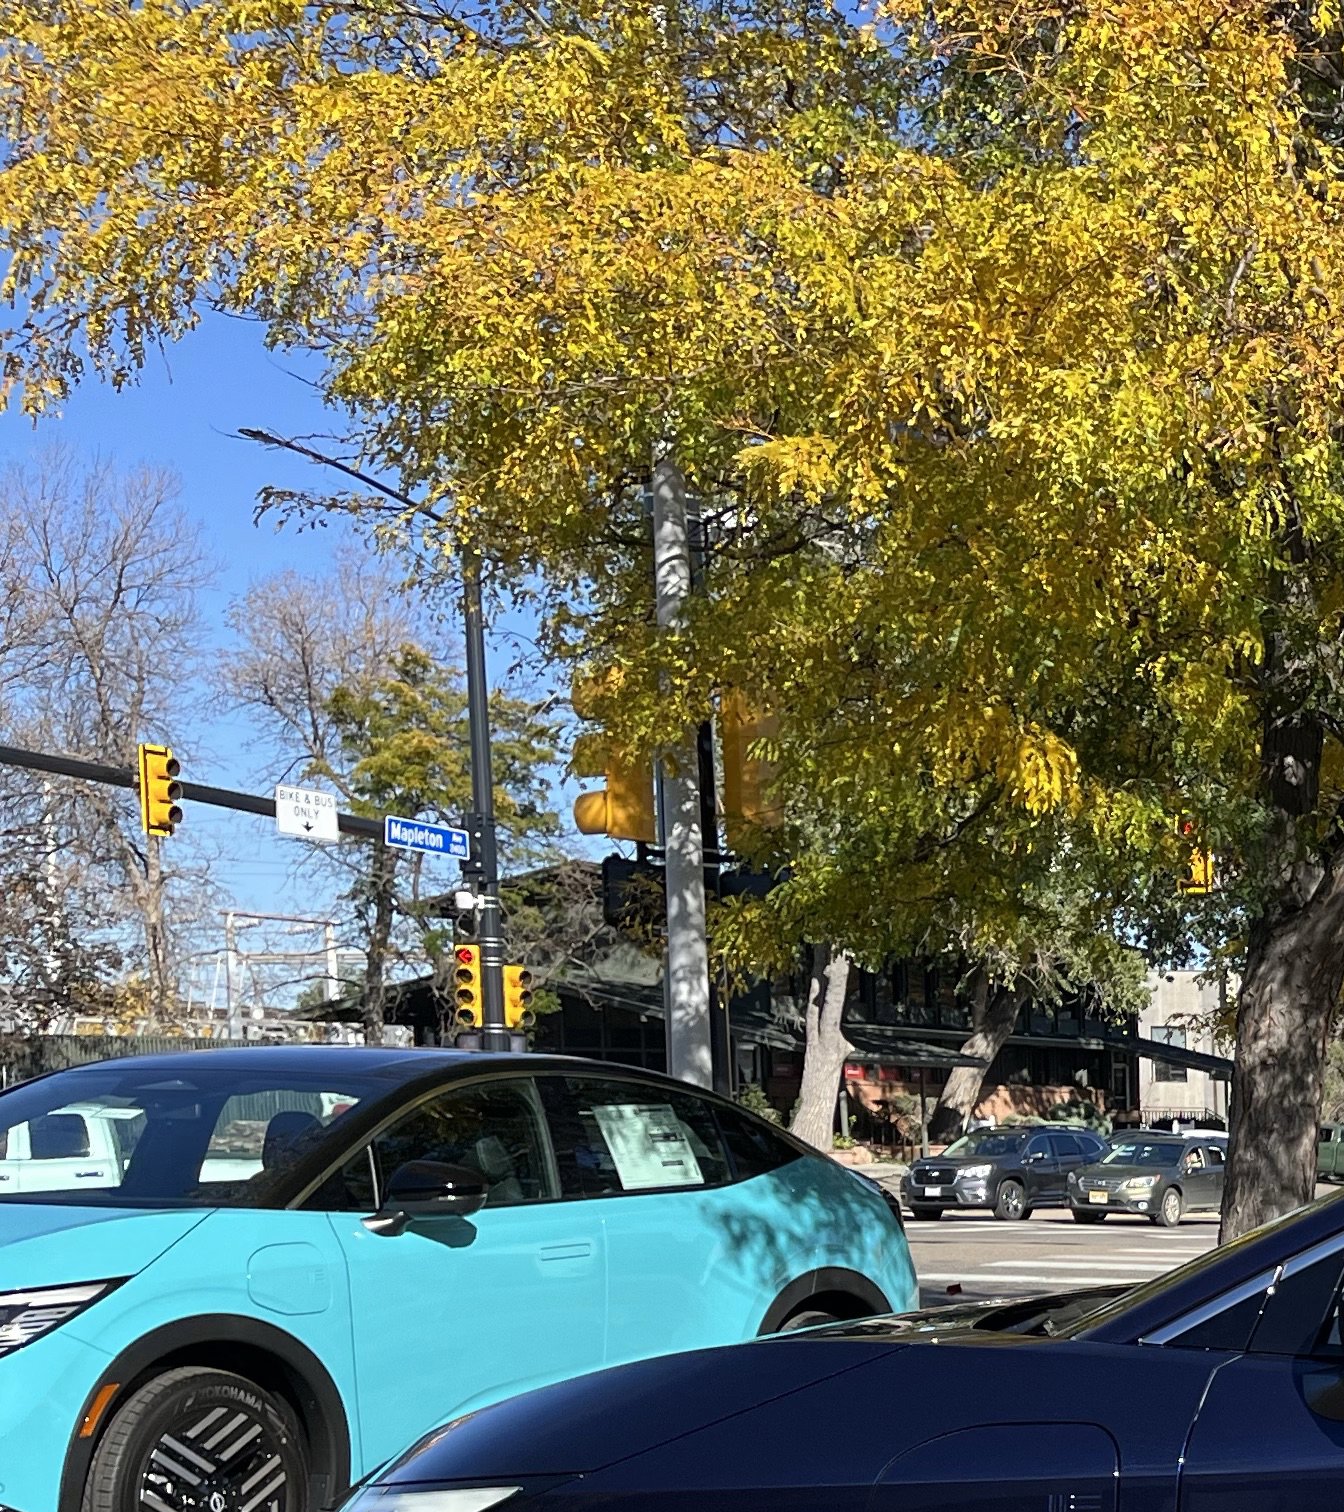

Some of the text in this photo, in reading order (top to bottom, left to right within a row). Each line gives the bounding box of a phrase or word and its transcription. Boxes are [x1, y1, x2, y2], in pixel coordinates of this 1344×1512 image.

[279, 789, 333, 808] BIKE & BUS
[293, 805, 320, 820] ONLY
[391, 821, 444, 849] Mapleton
[197, 1384, 264, 1413] YOKOHAMA
